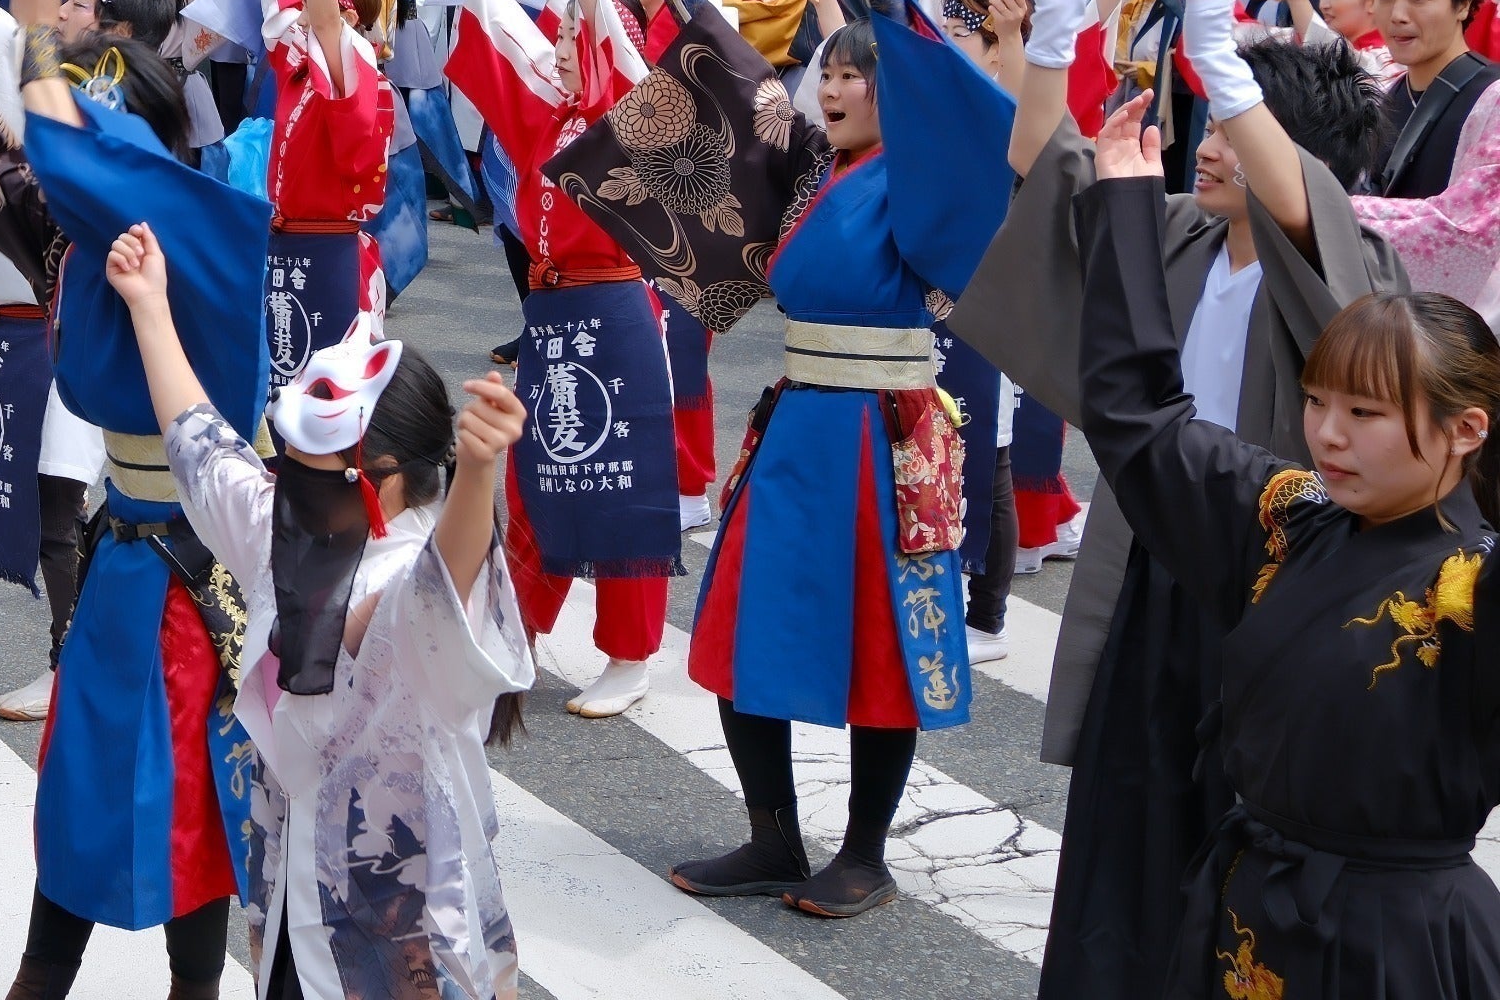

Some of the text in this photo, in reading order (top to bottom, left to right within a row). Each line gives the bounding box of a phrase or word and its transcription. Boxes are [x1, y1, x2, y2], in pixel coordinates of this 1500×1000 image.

[3, 403, 15, 462] 千客
[547, 364, 587, 453] 蕎麦
[608, 377, 631, 439] 千客
